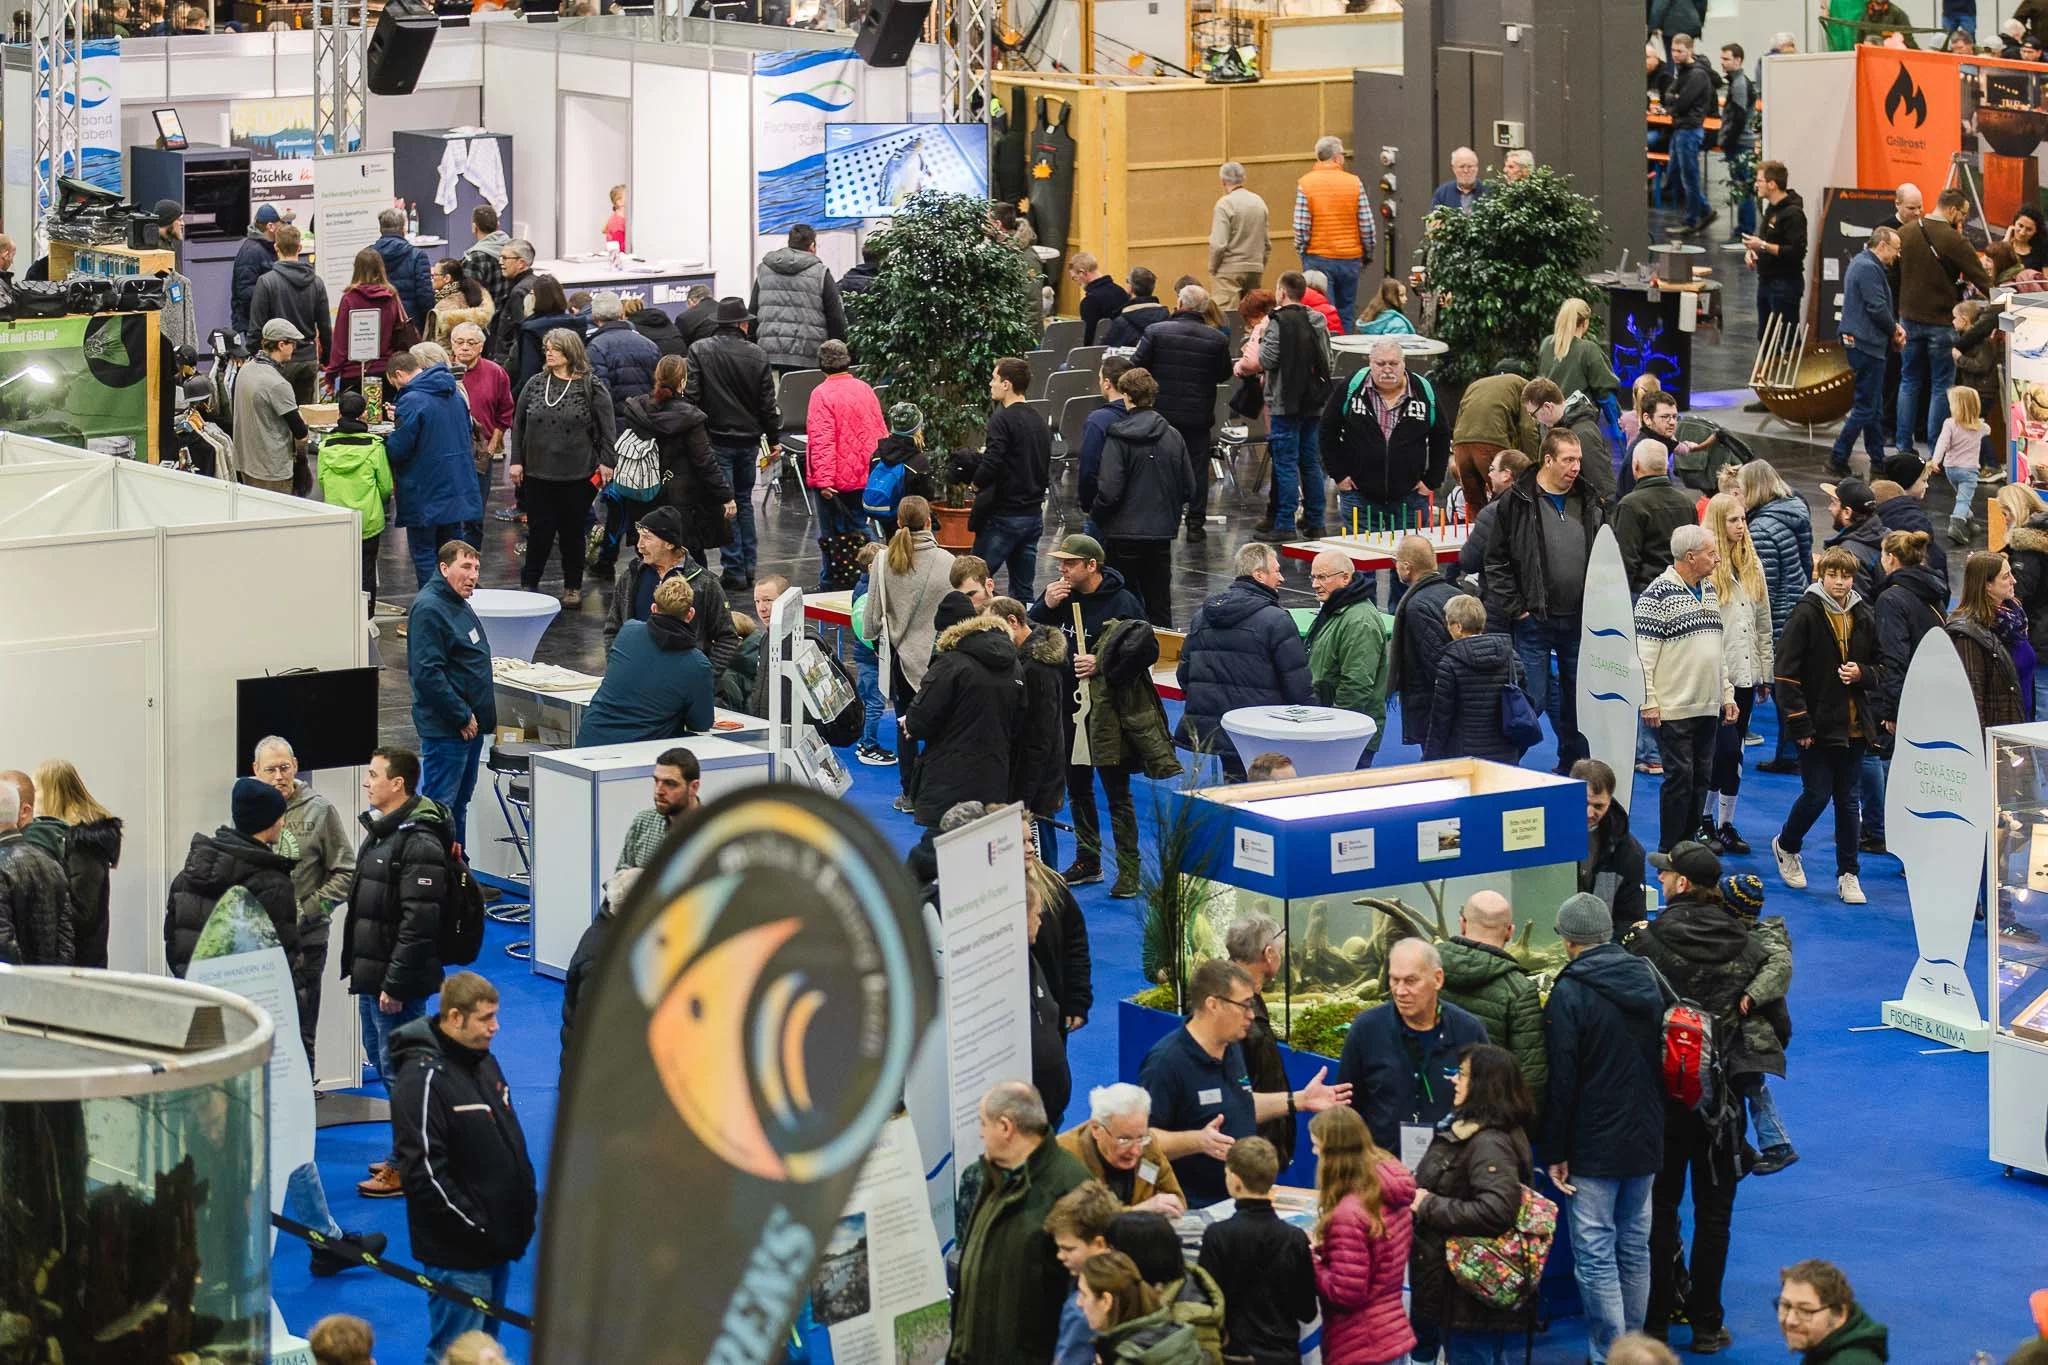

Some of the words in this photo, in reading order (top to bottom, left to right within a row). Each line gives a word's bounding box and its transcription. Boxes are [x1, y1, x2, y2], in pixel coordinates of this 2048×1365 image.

[250, 170, 293, 183] Raschke
[26, 330, 45, 342] 650
[1914, 760, 1968, 785] GEWÄSSER
[1890, 1009, 1923, 1032] FISCHE
[1925, 1021, 1933, 1034] &
[1935, 1023, 1967, 1045] KLIMA
